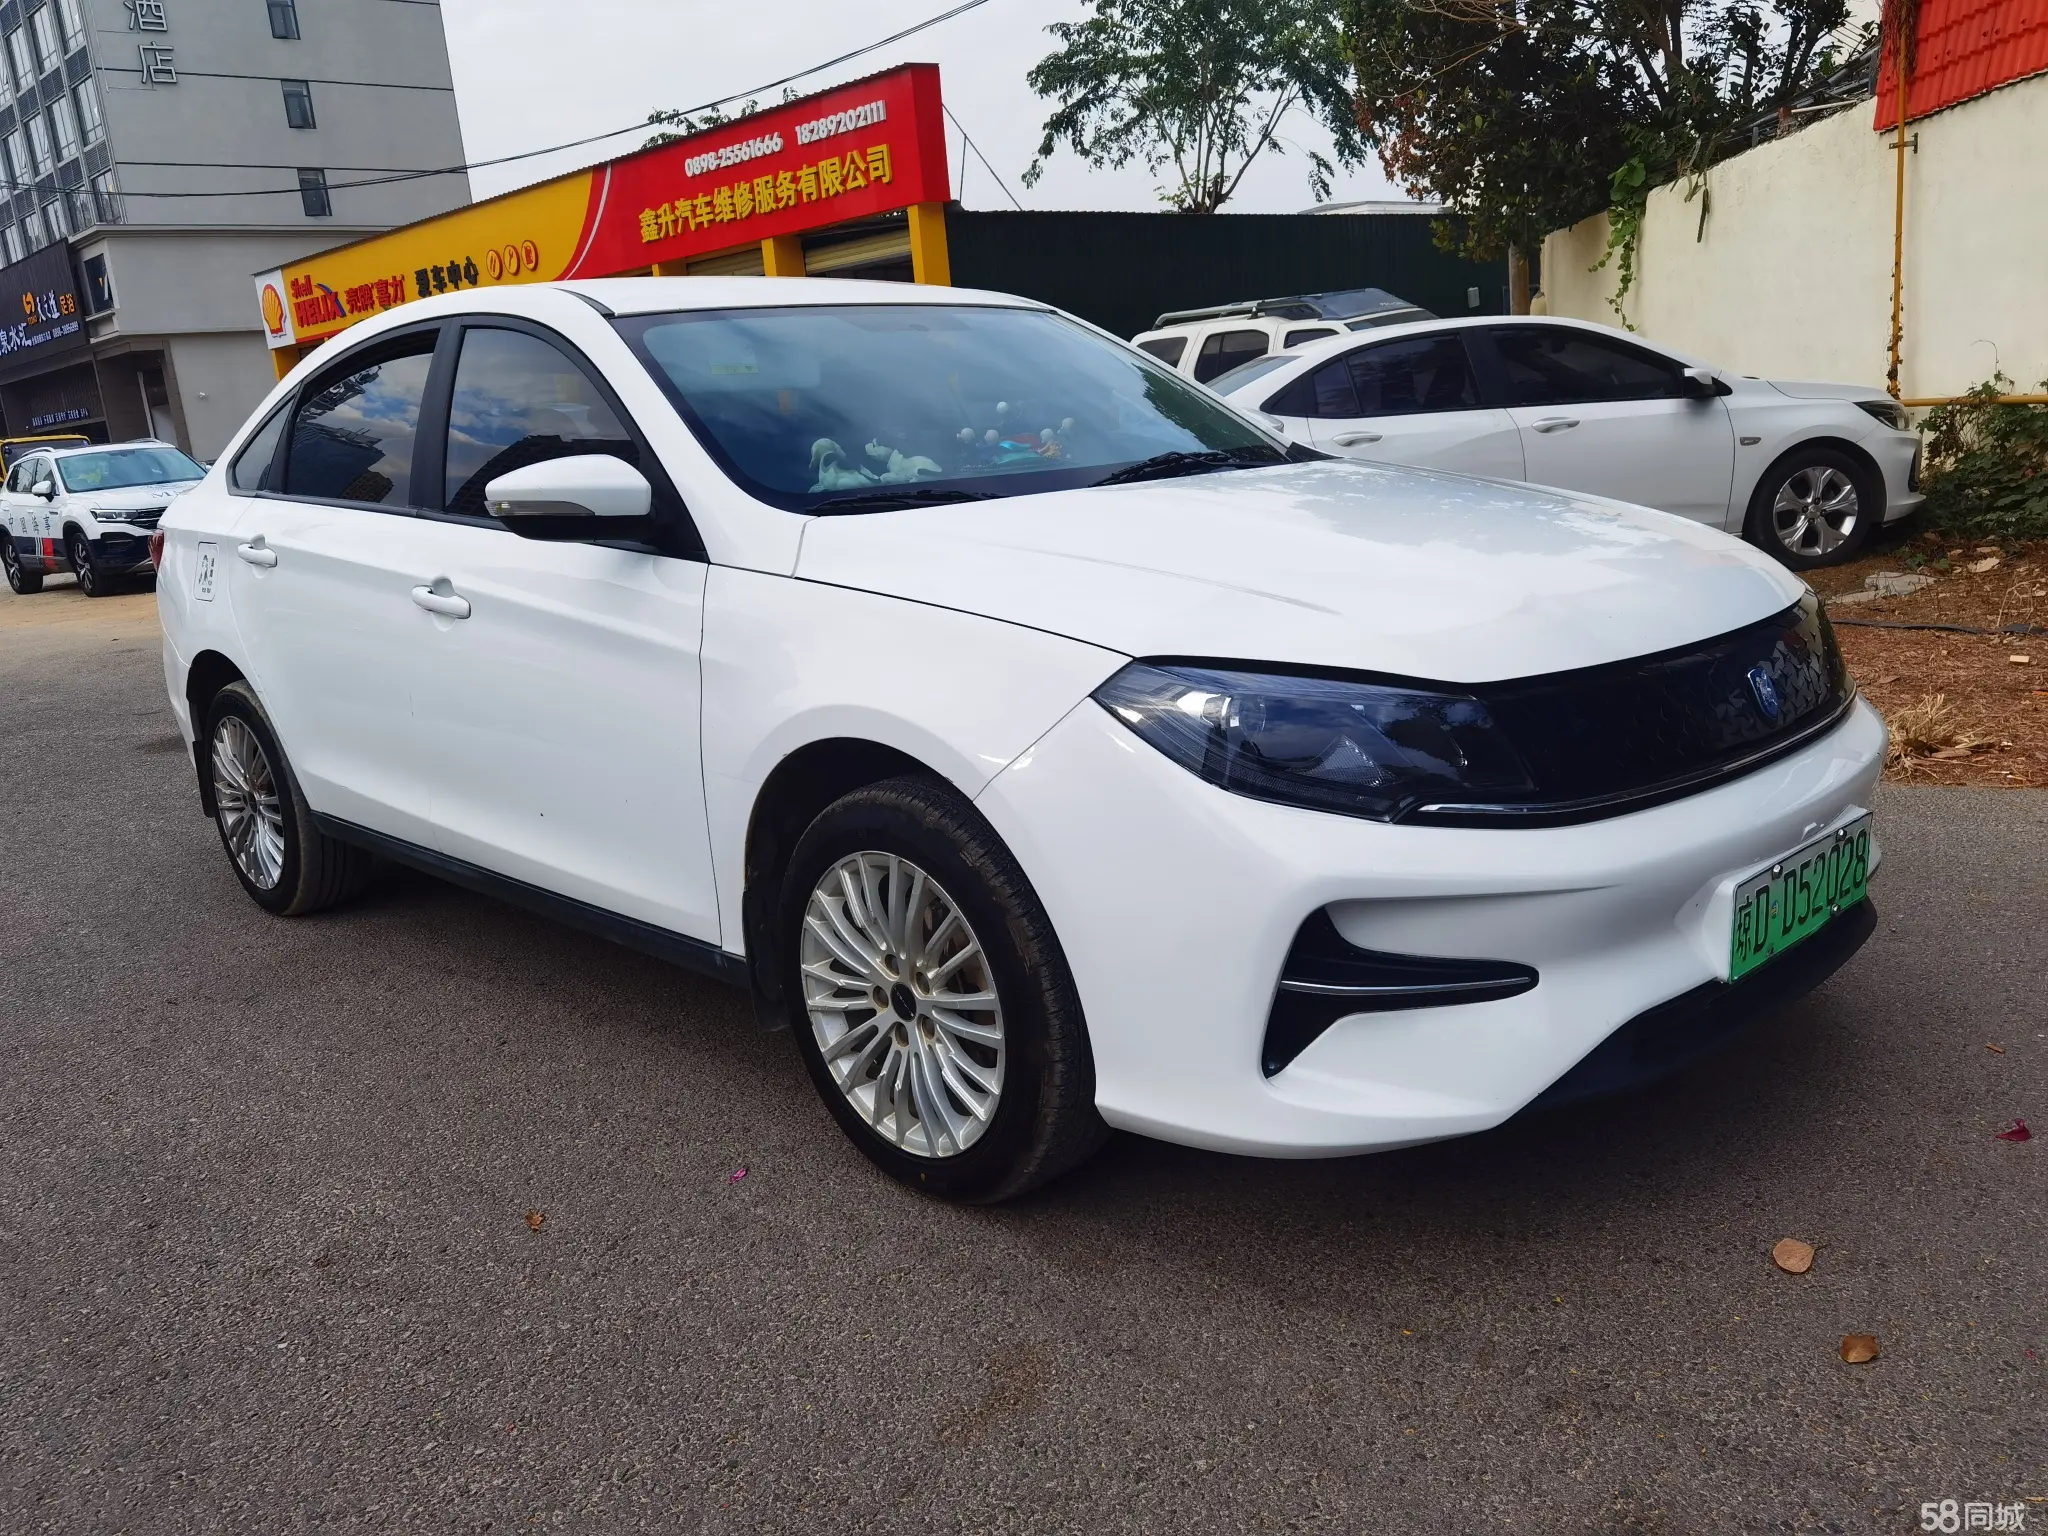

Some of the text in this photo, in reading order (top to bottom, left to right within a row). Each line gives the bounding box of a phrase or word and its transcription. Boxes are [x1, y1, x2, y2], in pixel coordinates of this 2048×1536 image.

[123, 0, 178, 84] 酒店
[684, 100, 887, 178] 0898-25561666 18289202111
[638, 143, 893, 244] 鑫升汽车维修服务有限公司
[290, 274, 313, 299] Shell
[414, 255, 479, 298] 爱车中心
[293, 283, 347, 328] HELIX
[0, 322, 33, 356] 泉水汇
